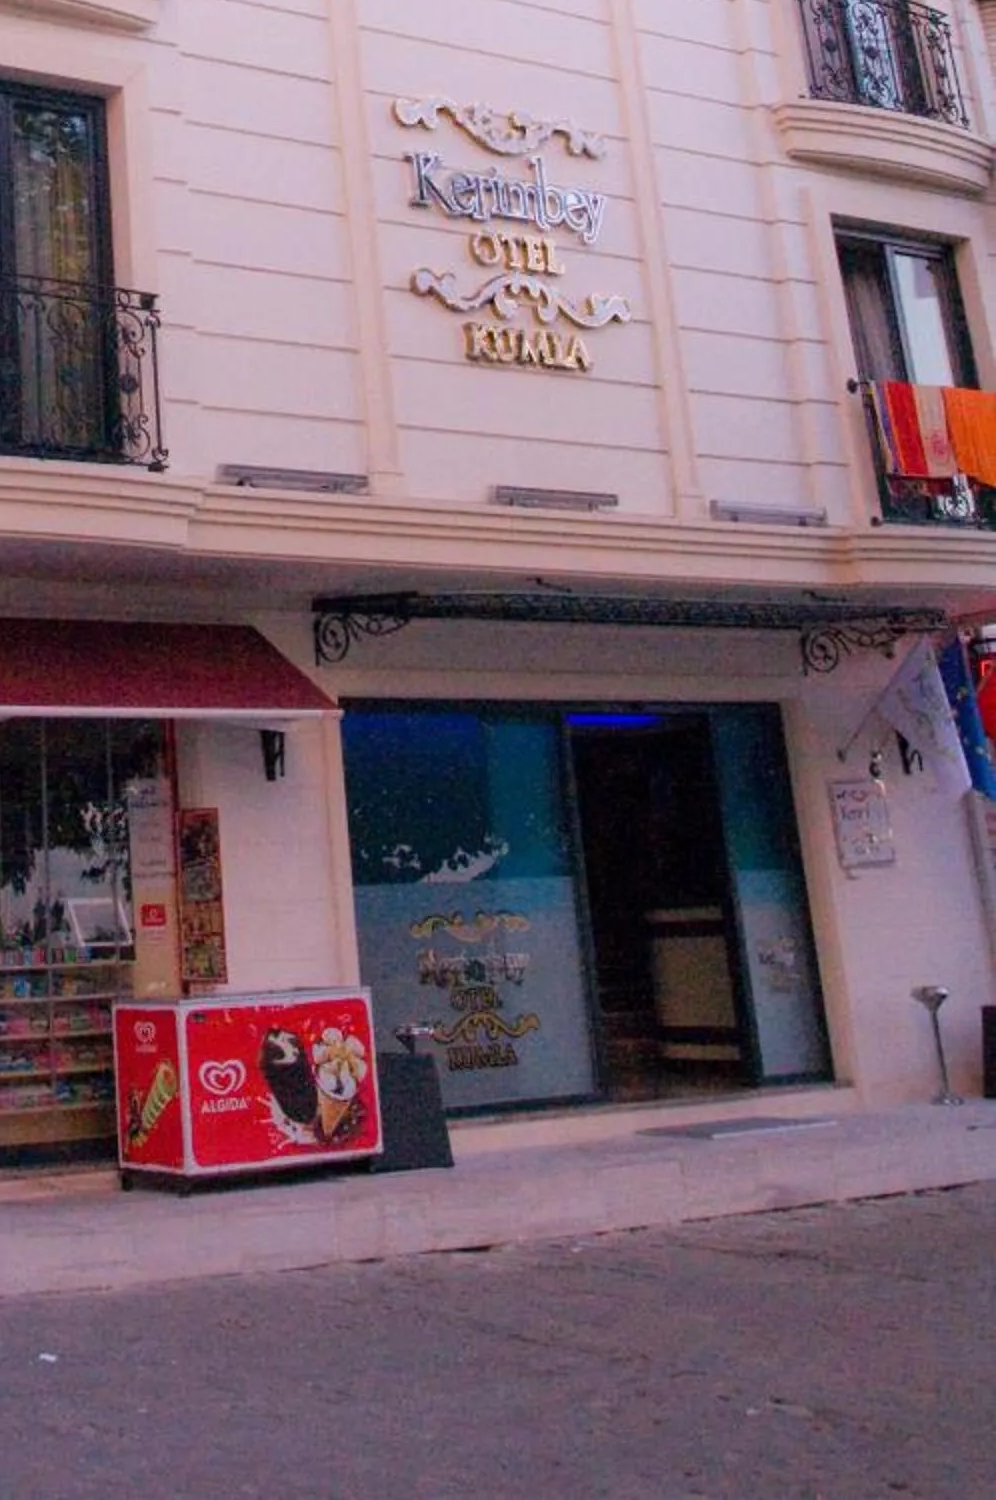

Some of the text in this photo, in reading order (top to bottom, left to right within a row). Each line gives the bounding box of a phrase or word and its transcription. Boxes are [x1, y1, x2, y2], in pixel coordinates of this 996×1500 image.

[406, 152, 604, 243] Kerimbey
[471, 229, 566, 275] OTEL
[464, 322, 594, 372] KUMLA
[200, 1097, 249, 1114] ALGIDA
